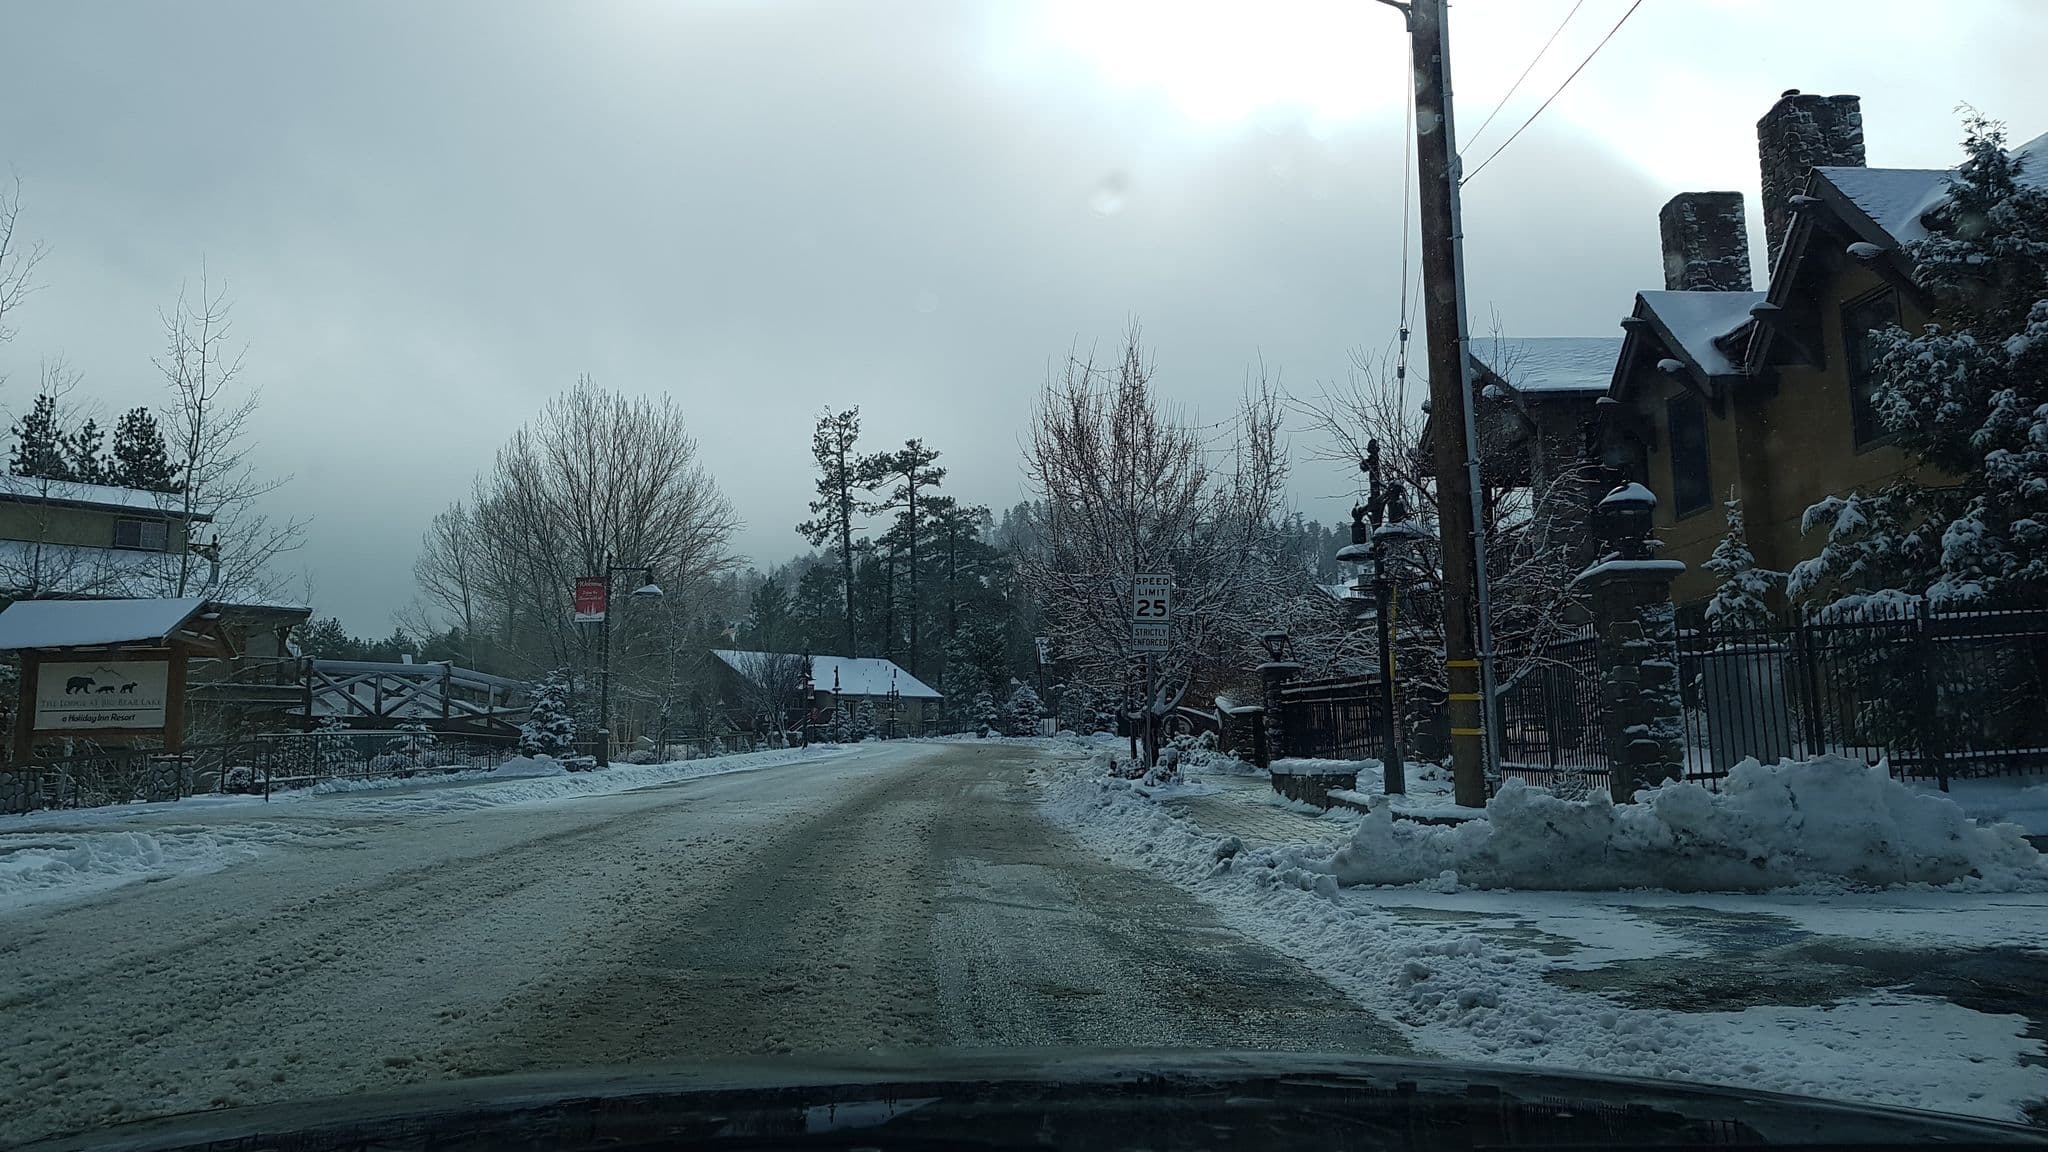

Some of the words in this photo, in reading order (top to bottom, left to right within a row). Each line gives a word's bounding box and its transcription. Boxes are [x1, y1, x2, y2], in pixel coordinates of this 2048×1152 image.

[1135, 577, 1169, 585] SPEED
[1138, 588, 1167, 596] LIMIT
[1137, 599, 1167, 617] 25
[1135, 628, 1167, 637] STRICTLY
[1134, 638, 1168, 647] ENFORCED
[118, 698, 139, 706] BEAR
[68, 714, 97, 723] Holiday
[110, 713, 136, 721] Resort
